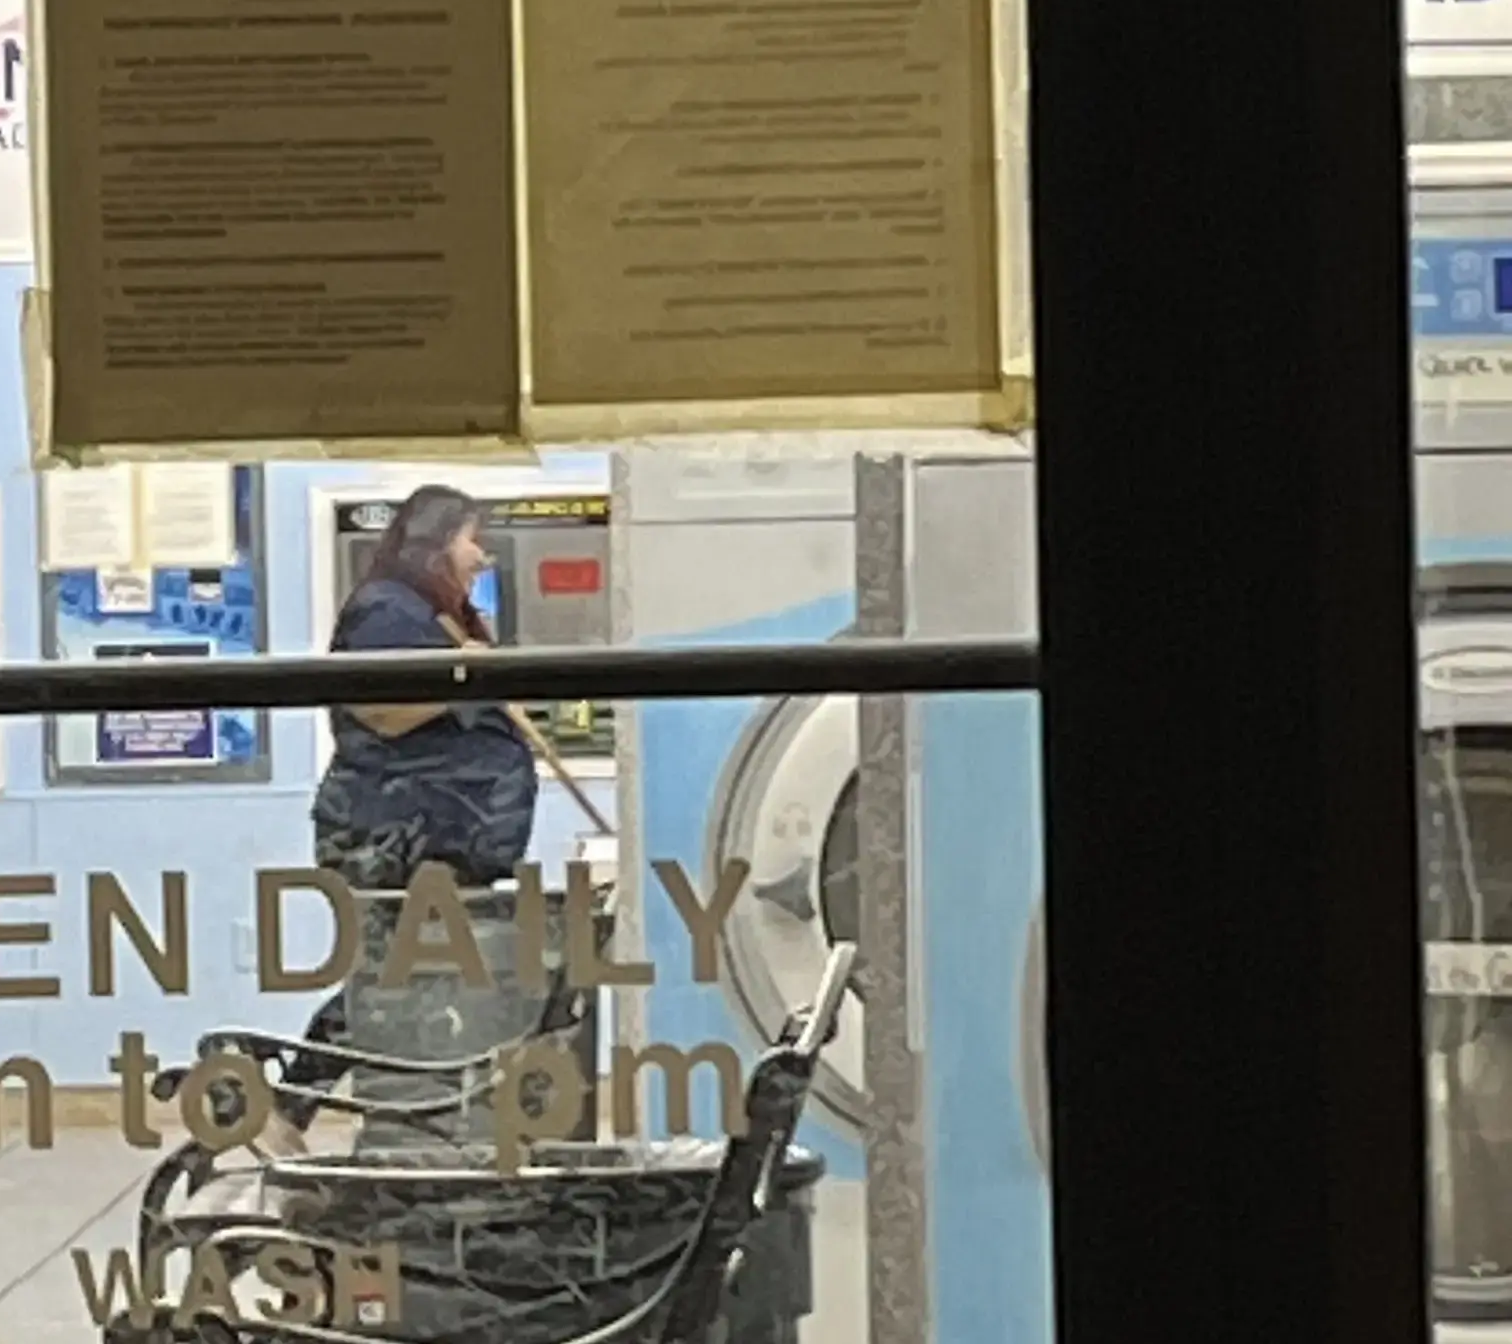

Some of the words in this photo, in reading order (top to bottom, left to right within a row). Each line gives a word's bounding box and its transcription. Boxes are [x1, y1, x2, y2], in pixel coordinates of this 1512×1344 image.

[254, 859, 751, 995] DAILY
[110, 1030, 275, 1152] to
[495, 1040, 751, 1175] pm
[70, 1243, 401, 1330] WASH
